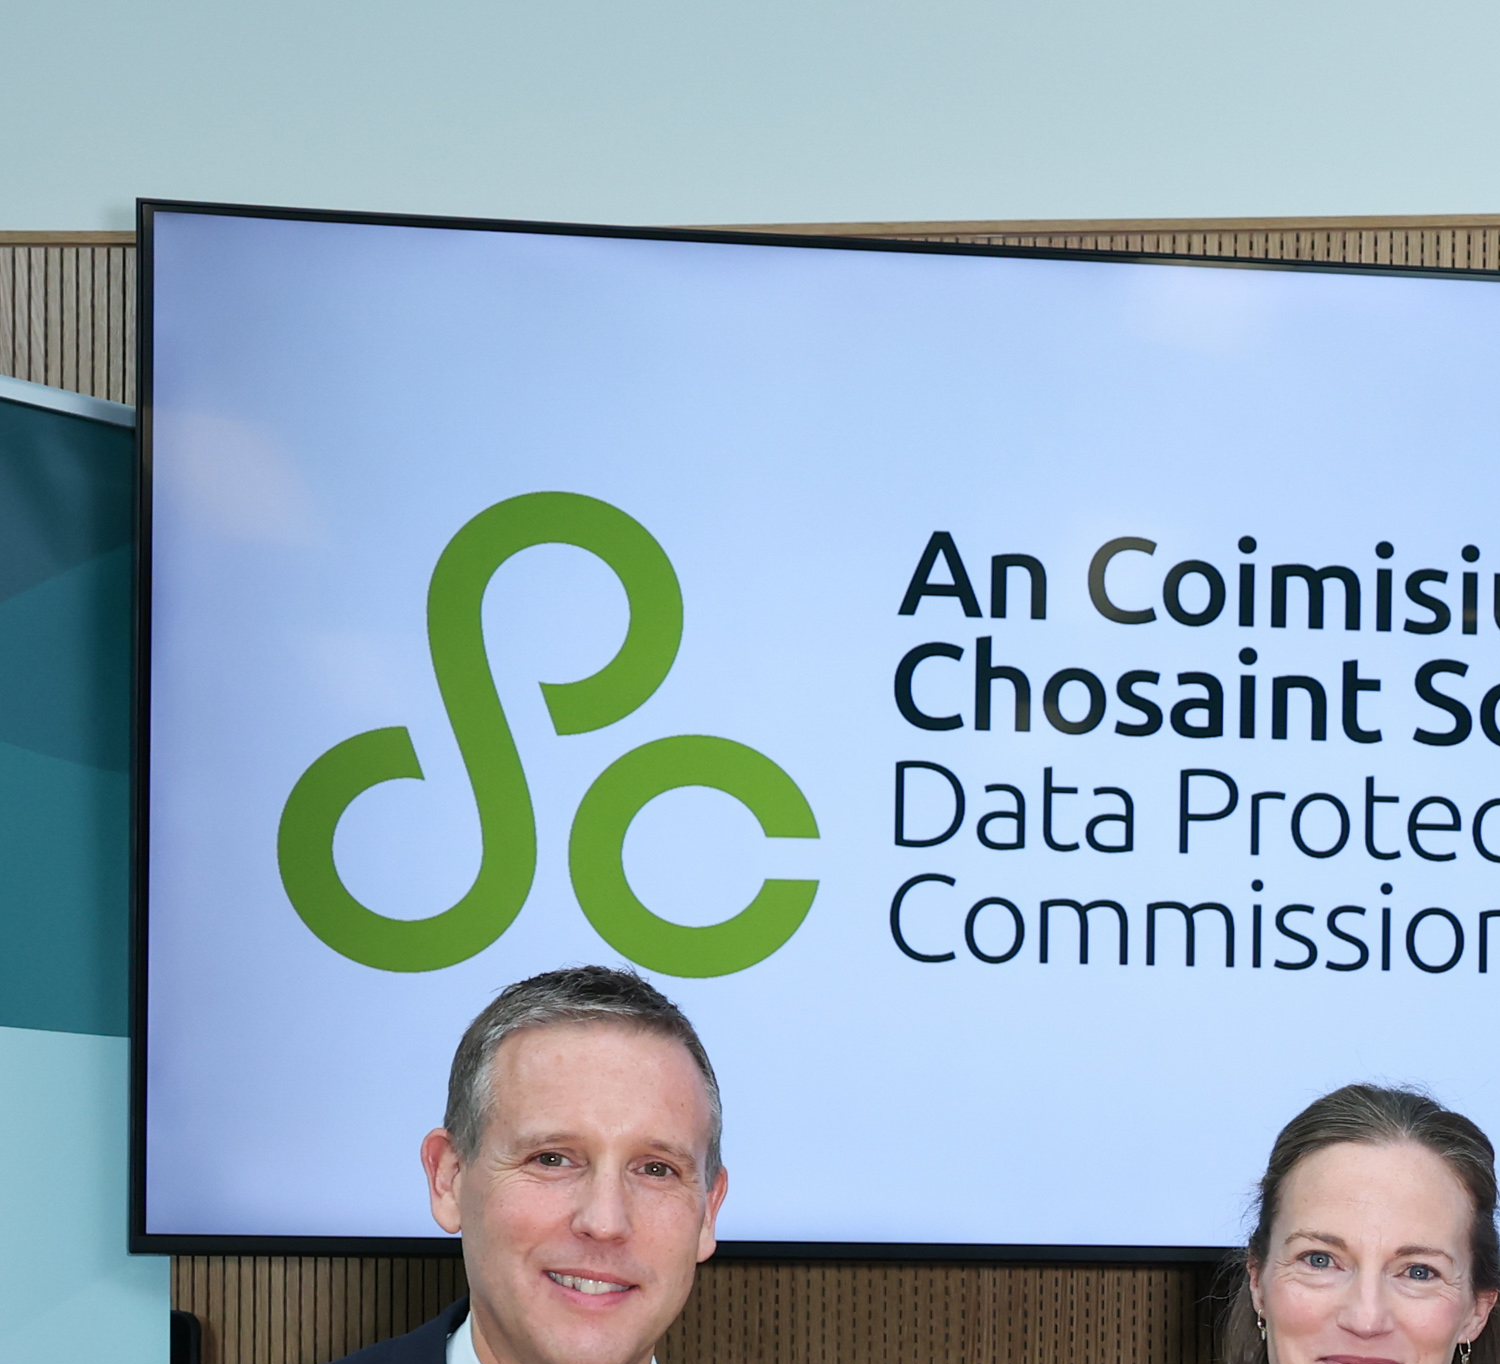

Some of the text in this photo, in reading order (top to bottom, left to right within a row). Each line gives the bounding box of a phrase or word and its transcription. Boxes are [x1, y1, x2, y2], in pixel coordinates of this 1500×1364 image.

[897, 531, 1047, 620] An
[893, 641, 1384, 745] Chosaint
[893, 760, 1135, 854] Data
